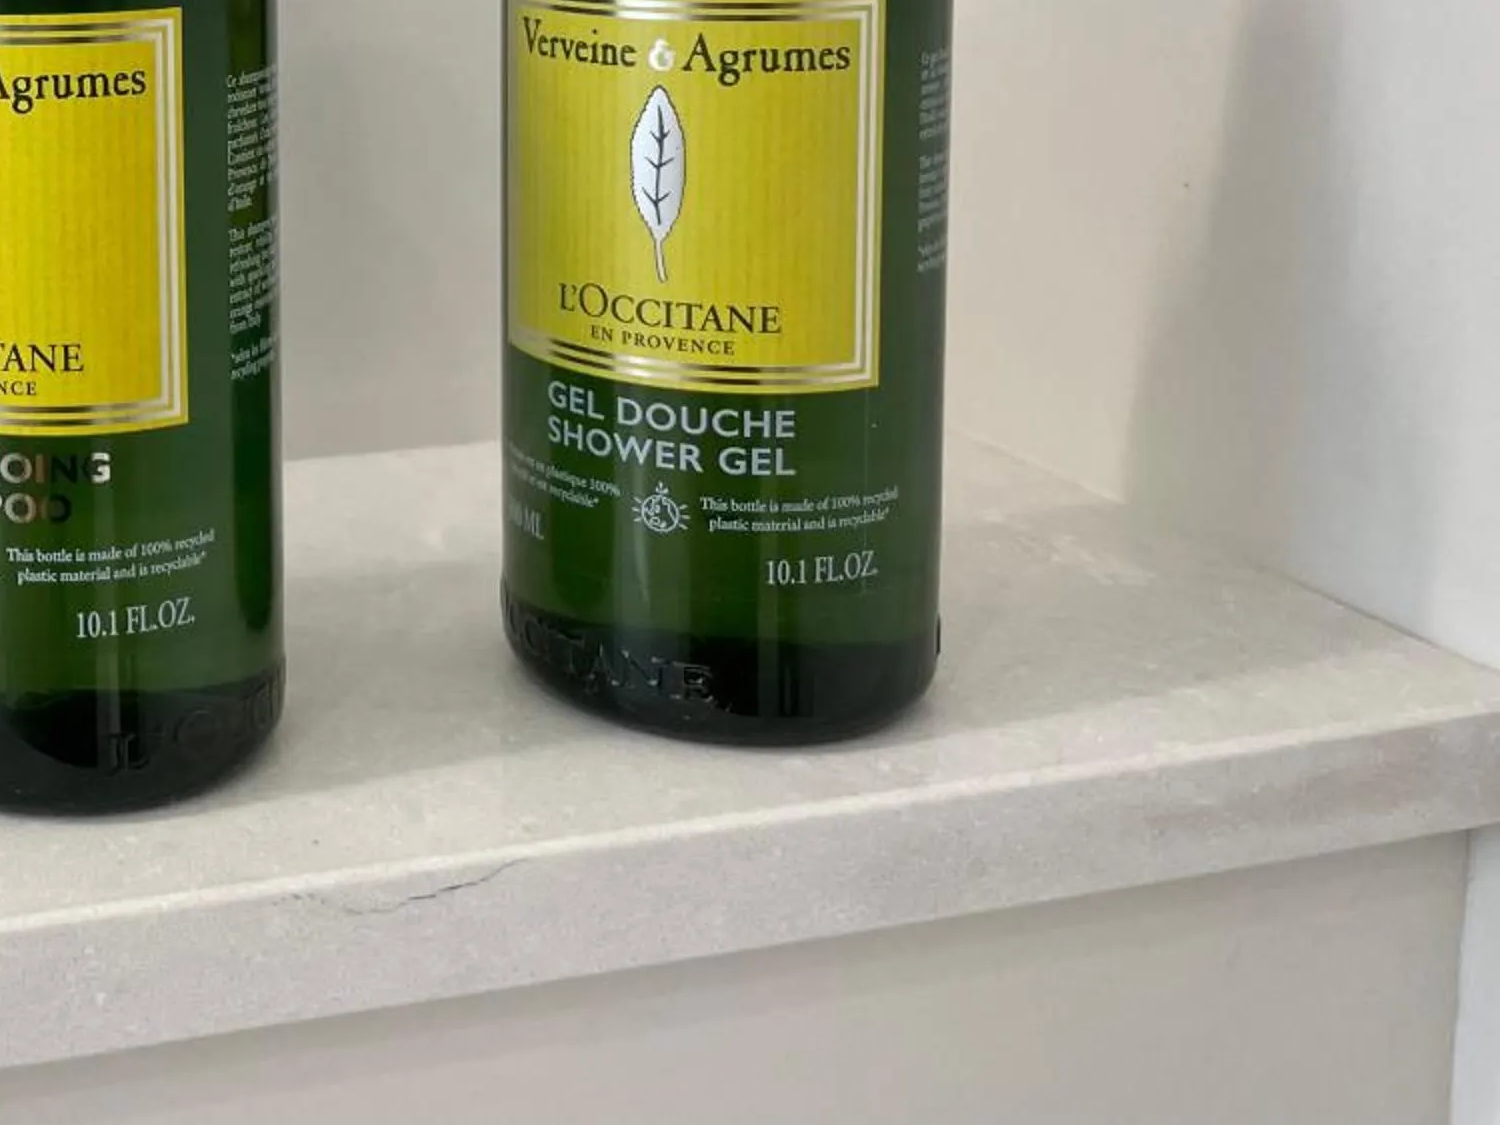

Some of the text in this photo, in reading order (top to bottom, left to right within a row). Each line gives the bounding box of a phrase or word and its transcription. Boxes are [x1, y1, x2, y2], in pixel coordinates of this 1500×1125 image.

[523, 16, 850, 87] Verveine & Agrumes
[591, 325, 735, 356] EN PROVENCE
[548, 380, 796, 439] GEL DOUCHE
[548, 414, 704, 473] SHOWER
[718, 447, 796, 476] GEL
[699, 496, 728, 512] This
[731, 498, 766, 513] bottle
[769, 499, 779, 513] is
[781, 498, 814, 513] made
[816, 497, 829, 510] of
[831, 495, 861, 510] 100%
[709, 516, 749, 532] plastic
[751, 517, 801, 533] material
[804, 515, 825, 530] and
[828, 515, 837, 528] is
[6, 547, 35, 563] This
[36, 548, 73, 563] bottle
[75, 548, 86, 562] is
[88, 546, 122, 562] made
[124, 543, 139, 558] of
[141, 539, 173, 557] 100%
[17, 568, 57, 586] plastic
[60, 566, 110, 583] material
[113, 562, 135, 579] and
[138, 561, 148, 576] is
[766, 558, 808, 586] 10.1
[76, 609, 119, 639] 10.1
